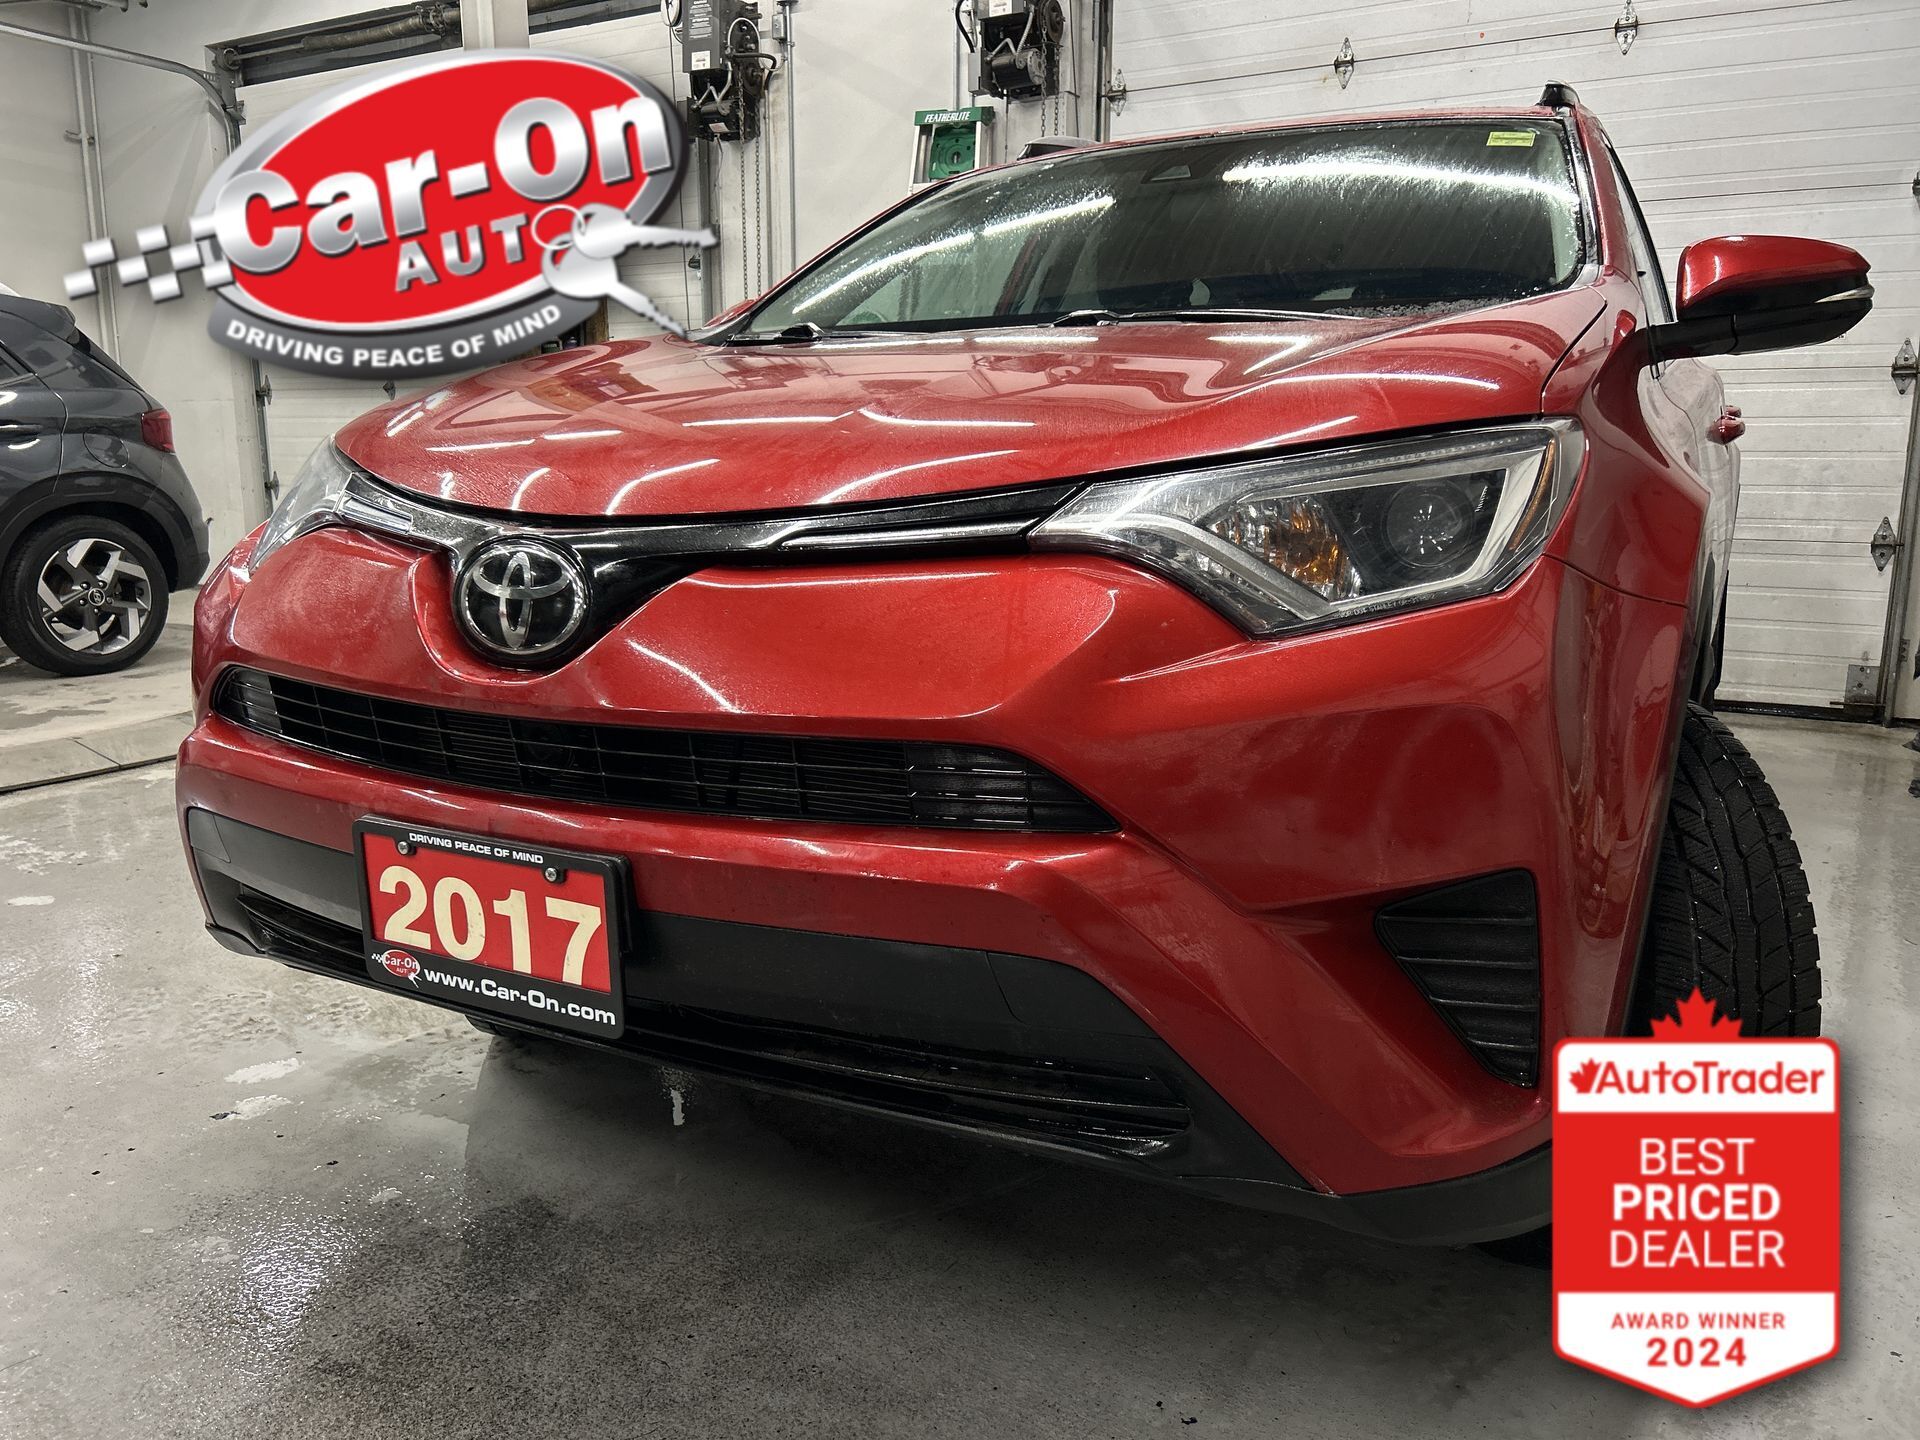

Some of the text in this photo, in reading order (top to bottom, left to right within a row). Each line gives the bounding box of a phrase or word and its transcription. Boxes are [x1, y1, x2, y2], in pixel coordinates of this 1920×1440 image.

[925, 112, 971, 123] FEATHERLITE
[409, 832, 544, 864] DRIVING PEACE OF MIND
[379, 865, 602, 986] 2017
[383, 953, 418, 969] Car-On
[424, 969, 616, 1026] www.Car-On.com
